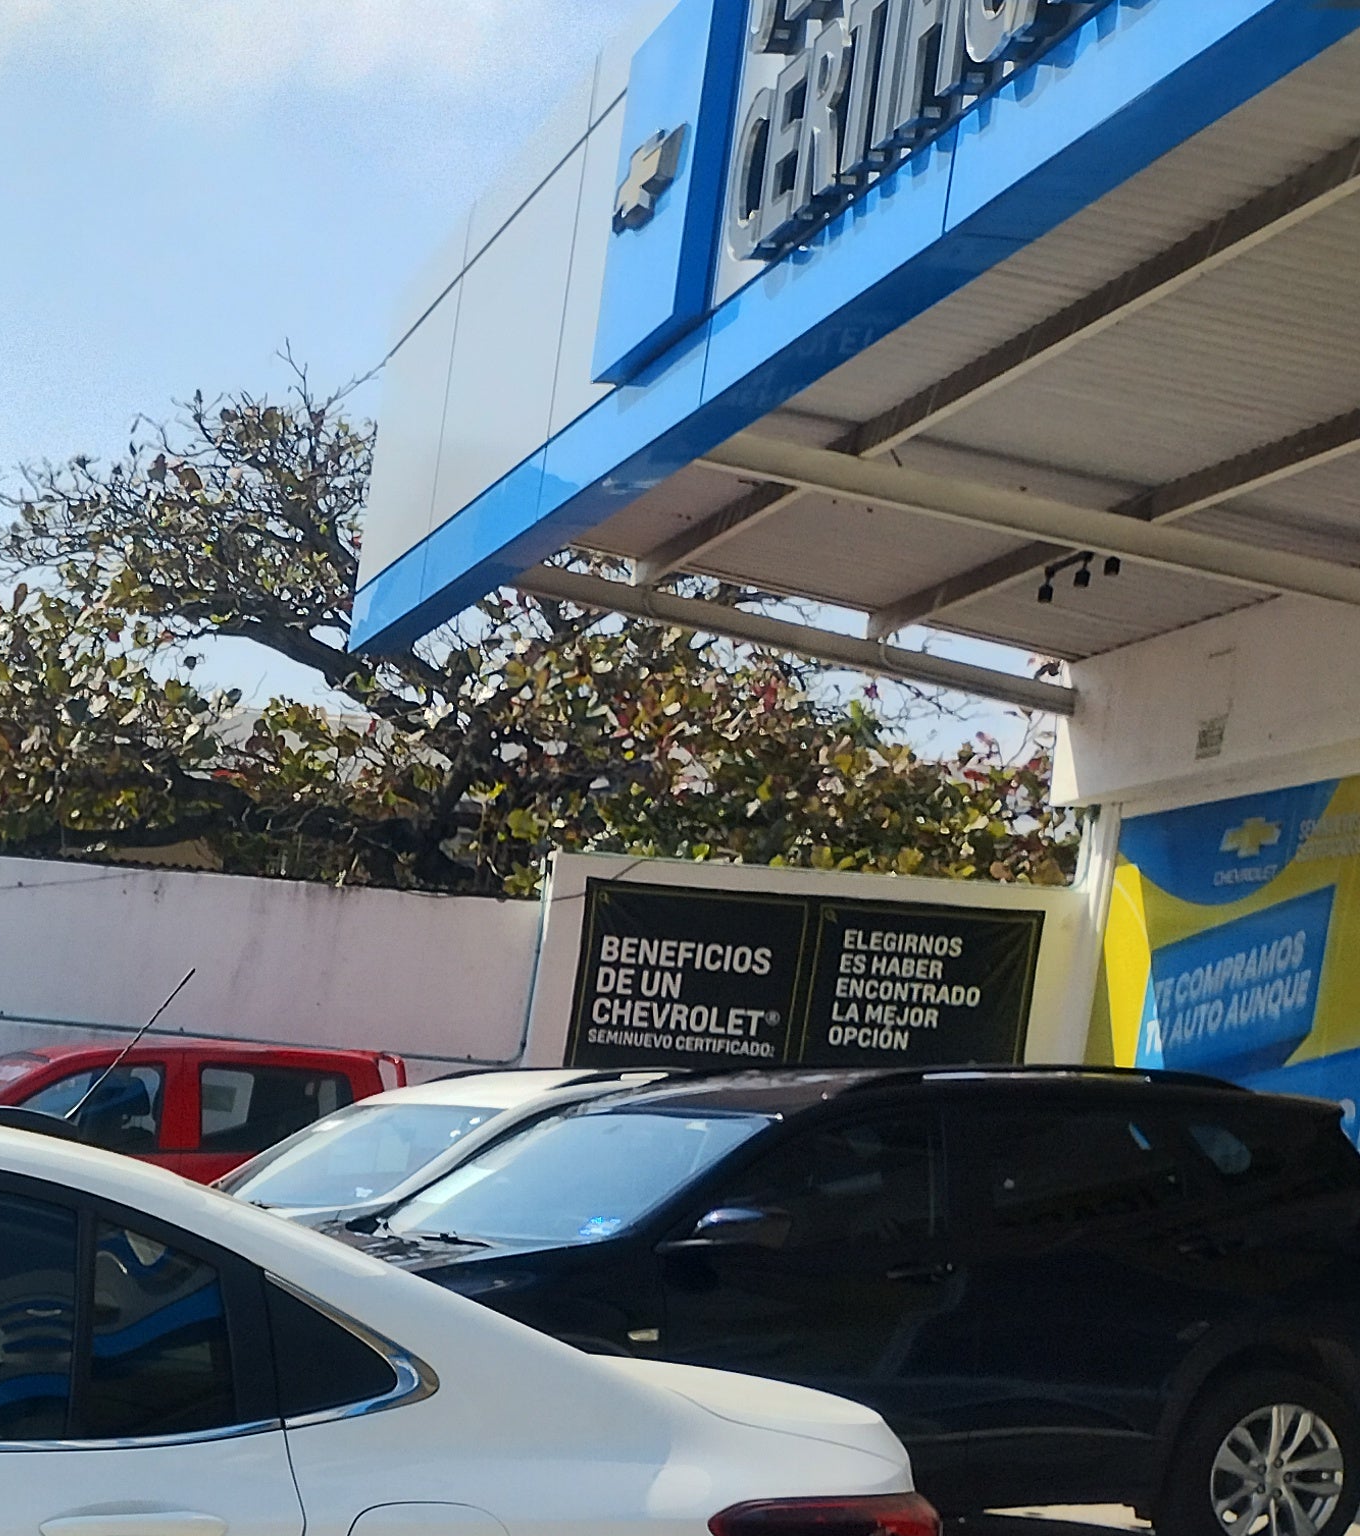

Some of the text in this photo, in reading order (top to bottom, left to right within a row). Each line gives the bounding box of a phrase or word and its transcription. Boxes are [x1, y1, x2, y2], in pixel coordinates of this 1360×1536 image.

[599, 934, 774, 976] BENEFICIOS
[843, 928, 964, 958] ELEGIRNOS
[839, 954, 944, 981] ES HABER
[1174, 930, 1306, 1001] COMPRAMOS
[595, 967, 683, 1000] DE UN
[835, 977, 982, 1008] ENCONTRADO
[831, 1002, 940, 1030] LA MEJOR
[1169, 998, 1225, 1048] AUTO
[1224, 969, 1312, 1031] AUNQUE
[586, 1028, 673, 1050] SEMINUEVO
[828, 1023, 910, 1052] OPCIÓN
